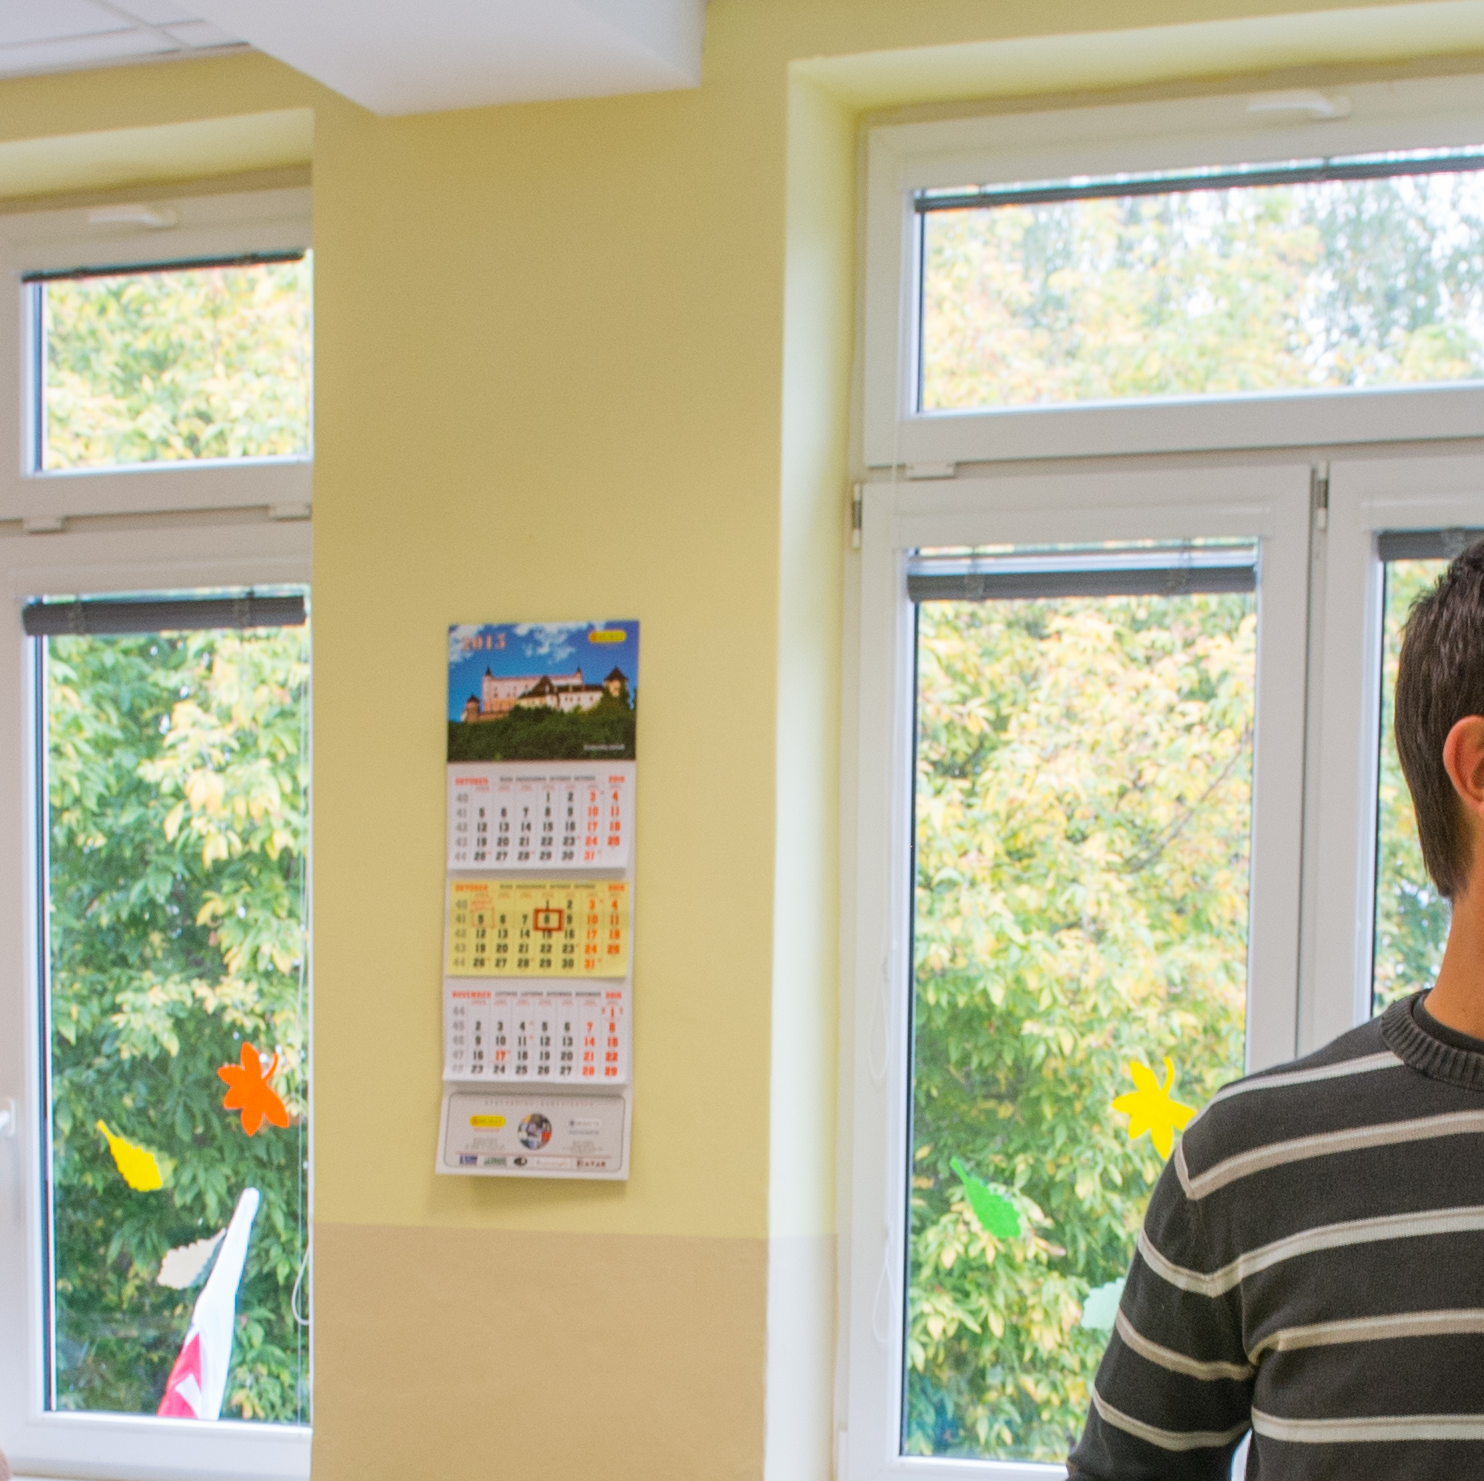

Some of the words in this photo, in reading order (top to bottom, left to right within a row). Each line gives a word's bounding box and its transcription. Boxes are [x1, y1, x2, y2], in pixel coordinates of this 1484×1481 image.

[461, 634, 506, 650] 2015
[545, 791, 551, 803] 1
[567, 790, 574, 803] 2
[589, 790, 597, 803] 3
[611, 789, 619, 803] 4
[522, 806, 530, 819] 7
[566, 805, 574, 819] 9
[587, 805, 599, 818] 10
[610, 805, 620, 818] 11
[476, 821, 488, 834] 12
[498, 821, 510, 833] 13
[520, 821, 532, 833] 14
[542, 821, 554, 833] 15
[564, 820, 576, 833] 16
[586, 819, 598, 832] 17
[609, 819, 621, 832] 18
[476, 836, 488, 848] 19
[496, 836, 510, 848] 20
[518, 836, 530, 848] 21
[540, 835, 554, 848] 22
[562, 835, 576, 848] 23
[585, 835, 598, 847] 24
[473, 850, 487, 862] 26
[495, 850, 509, 861] 27
[517, 850, 531, 861] 28
[539, 850, 553, 861] 29
[561, 850, 575, 861] 30
[583, 849, 595, 861] 31
[566, 898, 574, 911] 2
[589, 898, 596, 911] 3
[611, 898, 619, 912] 4
[521, 913, 529, 926] 7
[566, 913, 574, 925] 9
[587, 913, 599, 926] 10
[609, 913, 620, 926] 11
[475, 927, 487, 940] 12
[497, 927, 509, 940] 13
[519, 927, 531, 939] 14
[563, 927, 575, 940] 16
[586, 927, 598, 940] 17
[609, 927, 621, 941] 18
[475, 942, 487, 954] 19
[495, 942, 509, 955] 20
[518, 942, 529, 955] 21
[539, 943, 553, 955] 22
[562, 943, 575, 955] 23
[584, 943, 598, 955] 24
[472, 957, 486, 968] 26
[494, 957, 508, 968] 27
[517, 957, 530, 969] 28
[539, 957, 553, 969] 29
[561, 957, 575, 969] 30
[584, 958, 596, 969] 31
[474, 1020, 482, 1032] 2
[496, 1020, 504, 1033] 3
[519, 1020, 526, 1032] 4
[563, 1021, 571, 1034] 6
[586, 1021, 594, 1033] 7
[495, 1034, 507, 1047] 10
[517, 1035, 527, 1047] 11
[539, 1035, 551, 1048] 12
[562, 1035, 574, 1048] 13
[584, 1036, 596, 1047] 14
[473, 1049, 484, 1061] 16
[495, 1049, 507, 1062] 17
[517, 1049, 529, 1062] 18
[539, 1050, 551, 1062] 19
[560, 1050, 574, 1062] 20
[583, 1050, 595, 1062] 21
[605, 1050, 619, 1063] 22
[471, 1063, 484, 1075] 23
[493, 1063, 506, 1075] 24
[515, 1064, 528, 1075] 25
[537, 1064, 551, 1076] 26
[559, 1065, 573, 1076] 27
[582, 1065, 596, 1076] 28
[604, 1065, 618, 1077] 29
